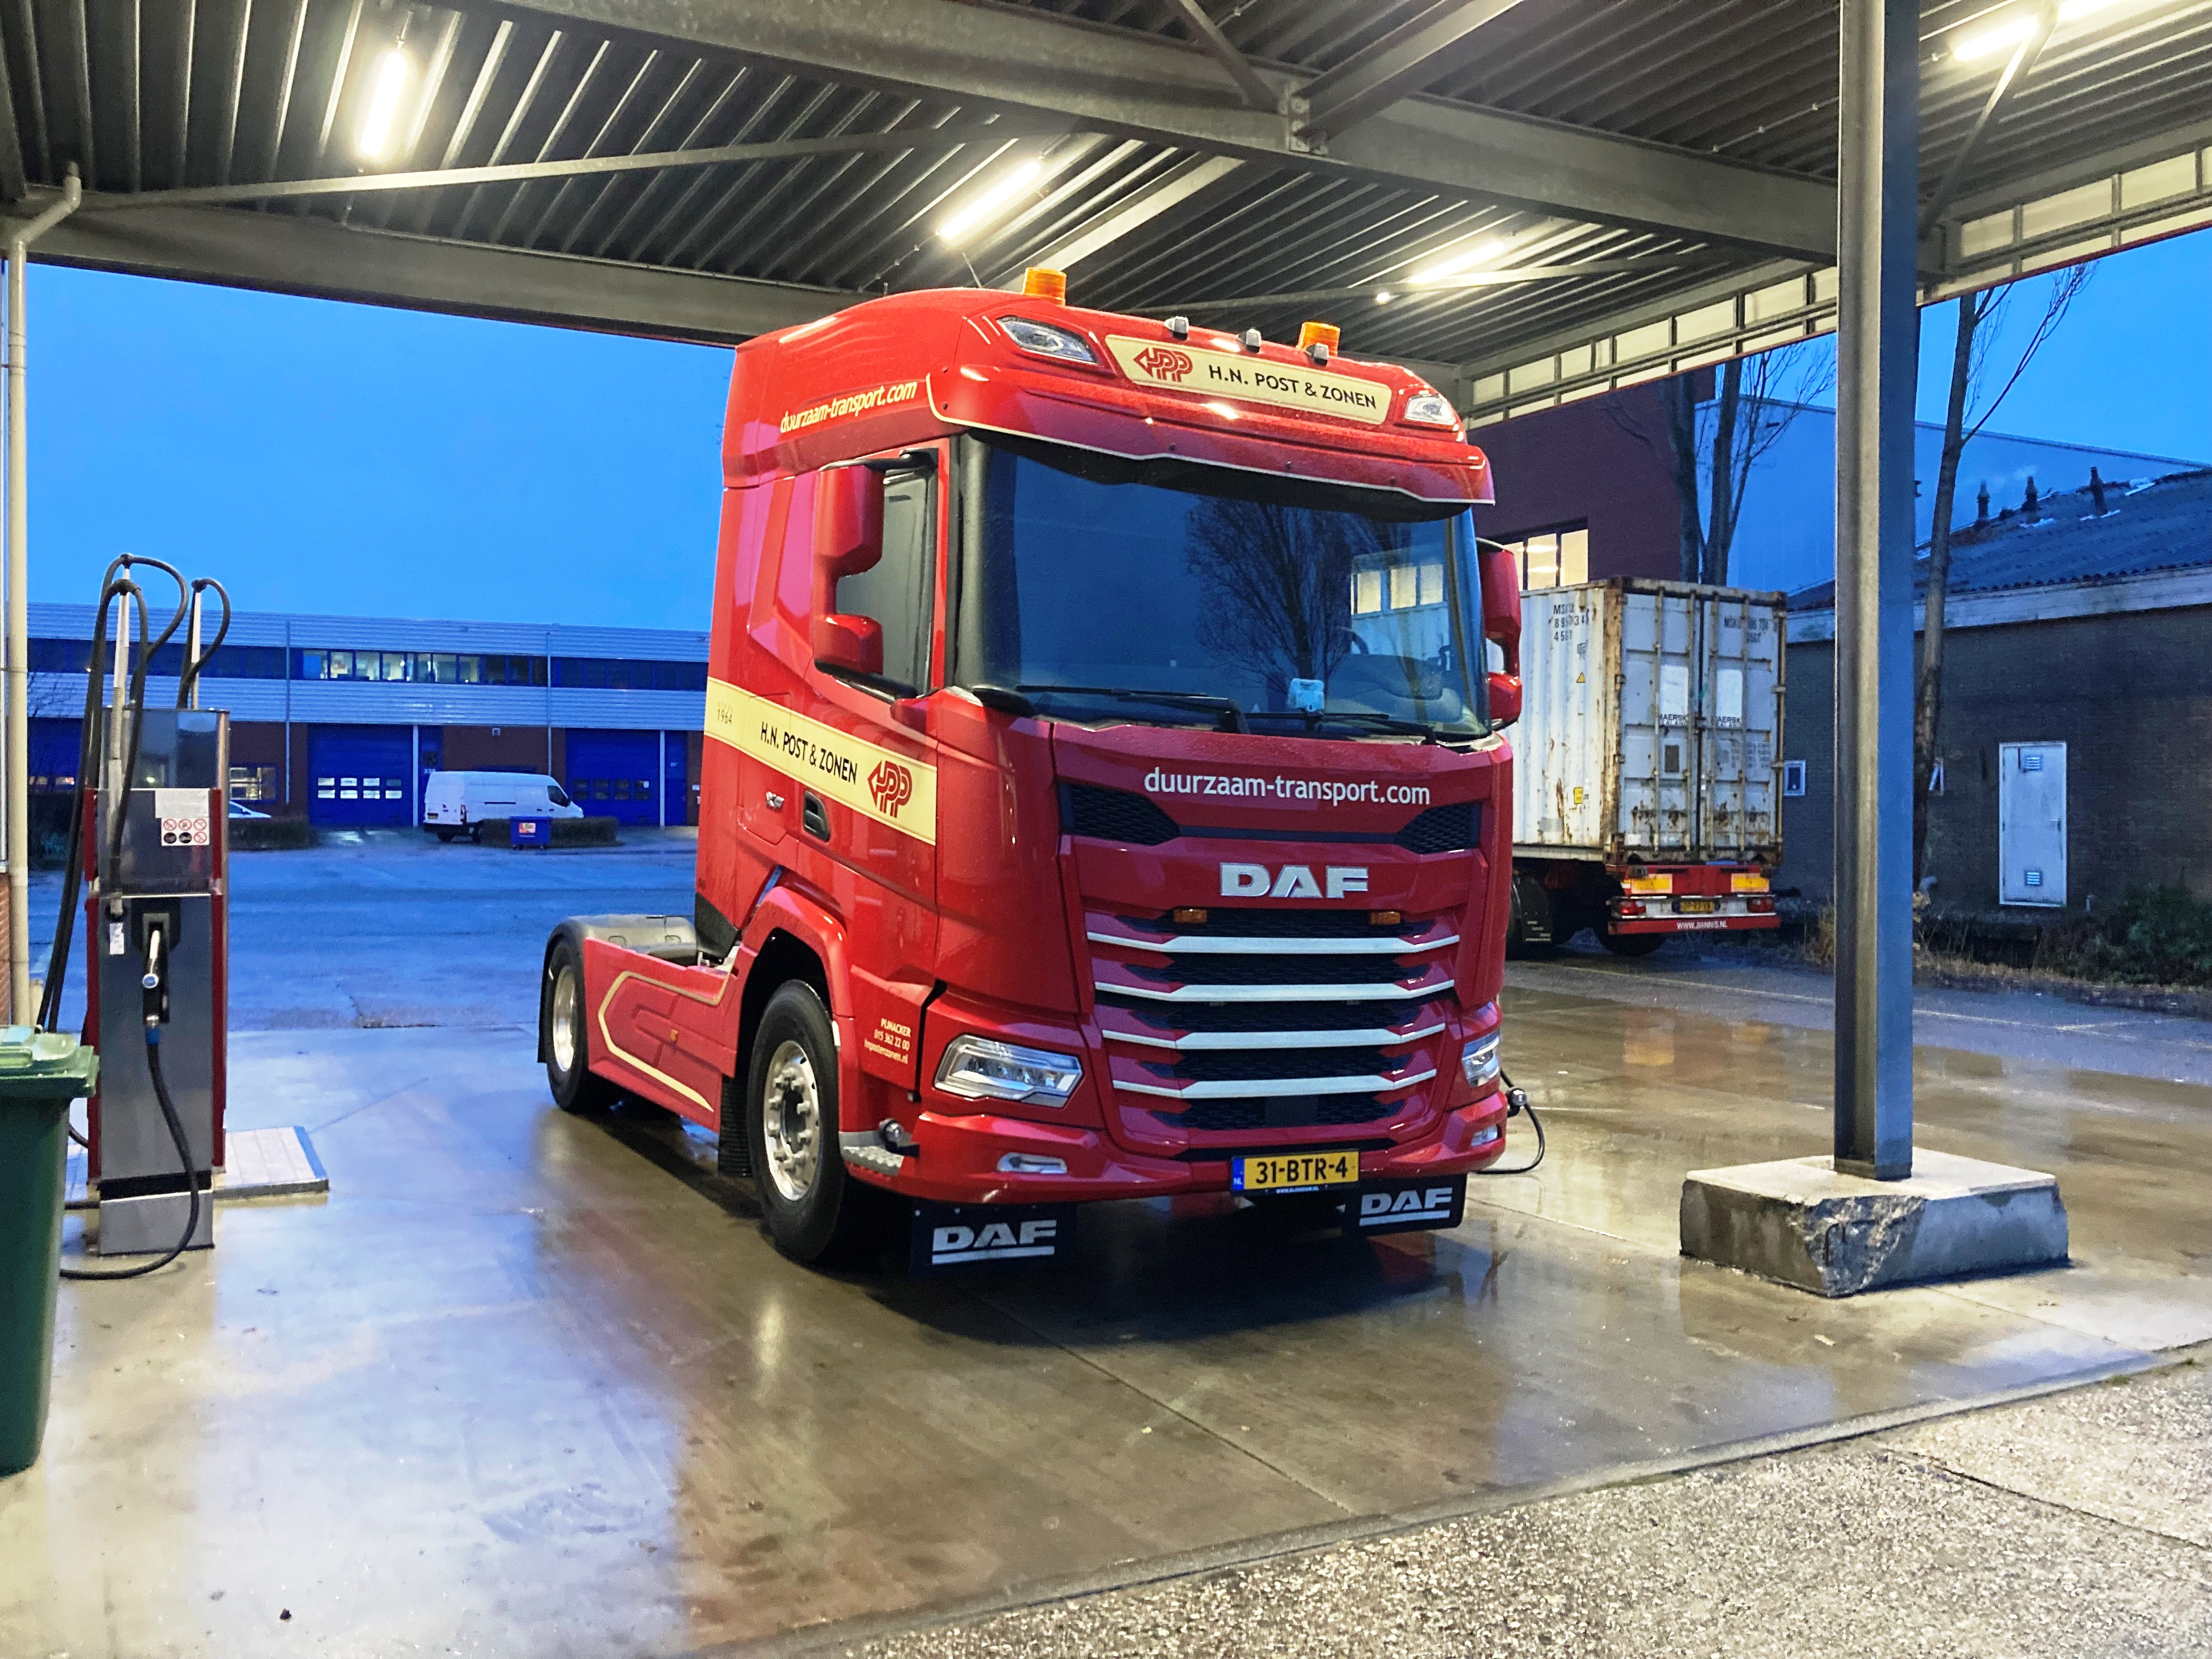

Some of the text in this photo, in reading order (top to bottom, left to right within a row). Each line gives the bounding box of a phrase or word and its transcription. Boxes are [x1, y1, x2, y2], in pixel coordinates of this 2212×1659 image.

[1209, 364, 1249, 385] H.N.
[1255, 373, 1299, 393] POST
[1305, 382, 1318, 397] &
[1320, 385, 1376, 409] ZONEN
[780, 381, 918, 433] duurzaam-transport.com
[718, 708, 732, 726] 1964
[760, 721, 779, 749] H.N.
[783, 731, 809, 761] POST
[809, 743, 817, 767] &
[819, 748, 858, 785] ZONEN
[1144, 766, 1431, 806] duurzaam-transport.com
[1220, 861, 1369, 899] DAF
[902, 1040, 910, 1051] 00
[1233, 1177, 1243, 1186] NL
[1256, 1156, 1348, 1184] 31-BTR-4
[1360, 1187, 1453, 1216] DAF
[933, 1219, 1057, 1252] DAF
